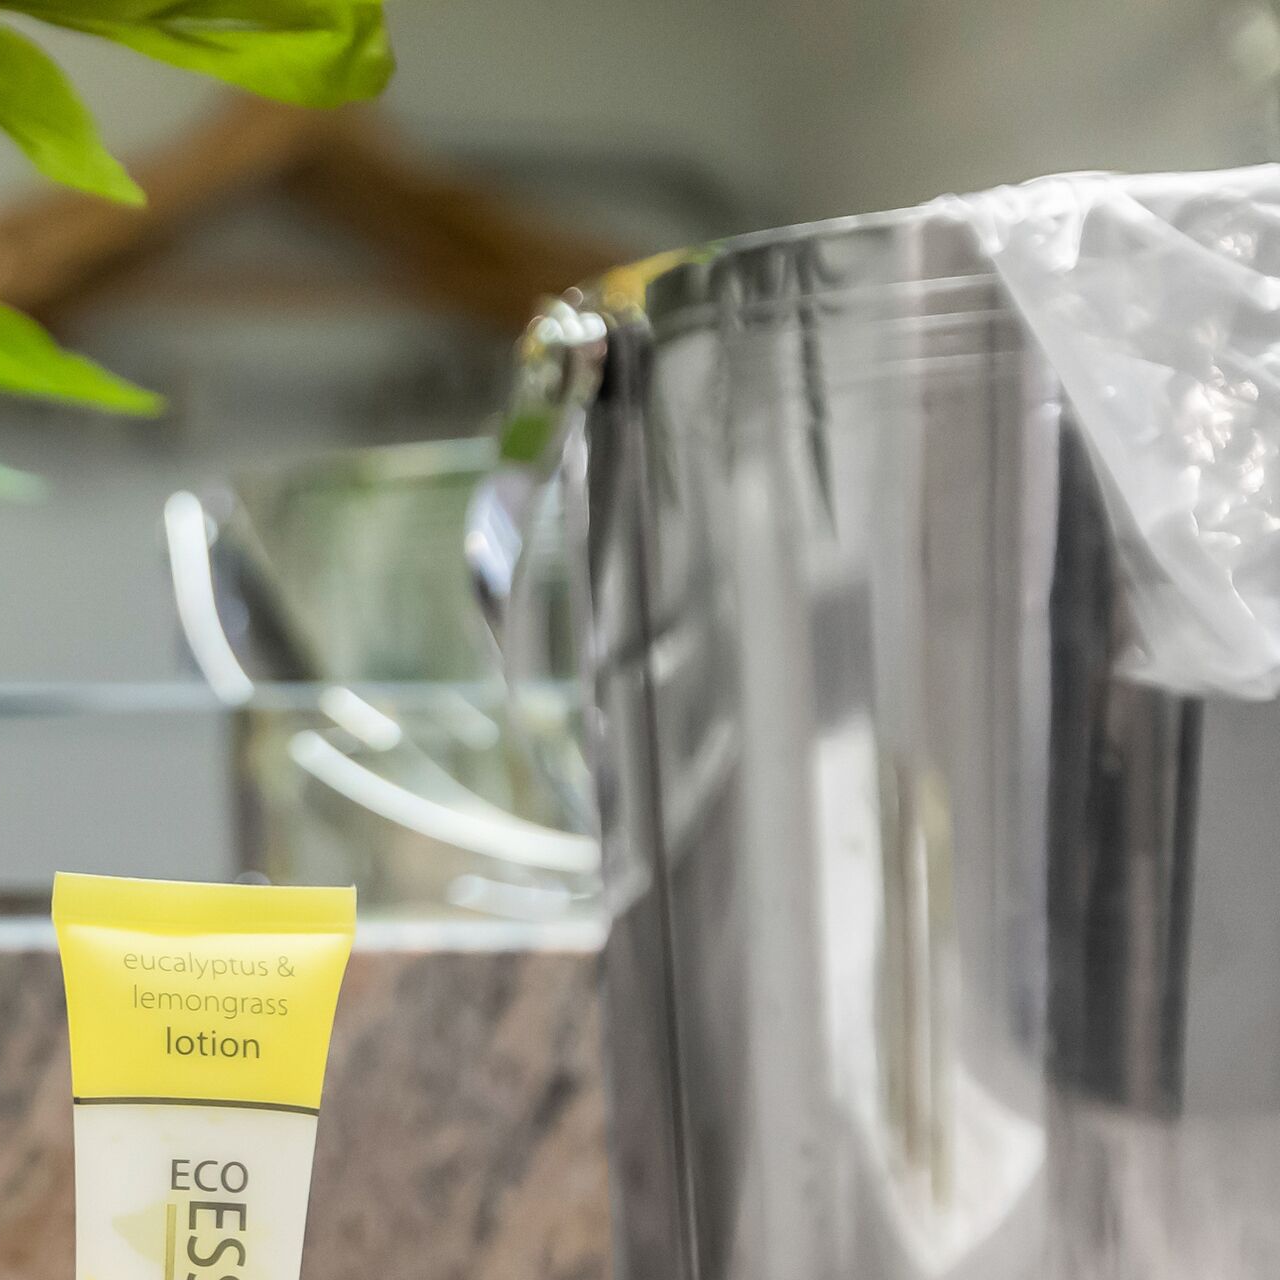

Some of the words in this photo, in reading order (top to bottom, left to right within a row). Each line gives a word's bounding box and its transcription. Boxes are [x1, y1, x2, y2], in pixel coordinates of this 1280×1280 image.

[123, 952, 268, 980] eucalyptus
[277, 956, 295, 977] &
[133, 984, 288, 1019] lemongrass
[166, 1026, 260, 1059] lotion
[171, 1159, 249, 1193] ECO
